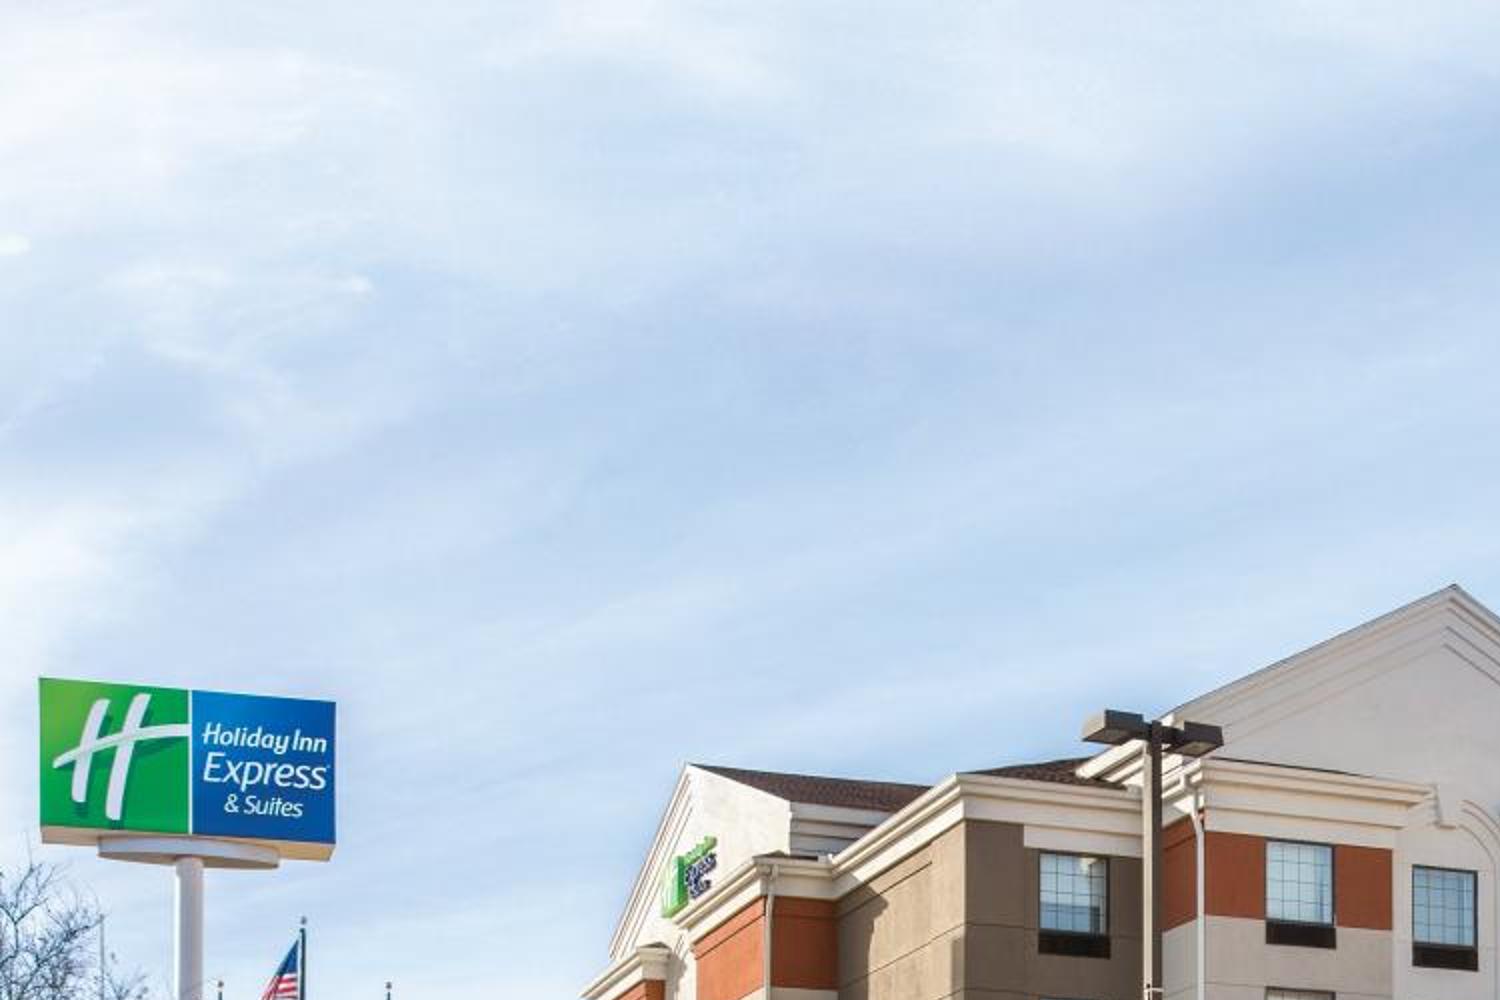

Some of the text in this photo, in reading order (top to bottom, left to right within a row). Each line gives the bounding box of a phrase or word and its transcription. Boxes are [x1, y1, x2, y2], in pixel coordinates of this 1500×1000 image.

[202, 721, 328, 755] Holiday Inn
[203, 751, 328, 792] Express
[224, 793, 305, 818] & Suites
